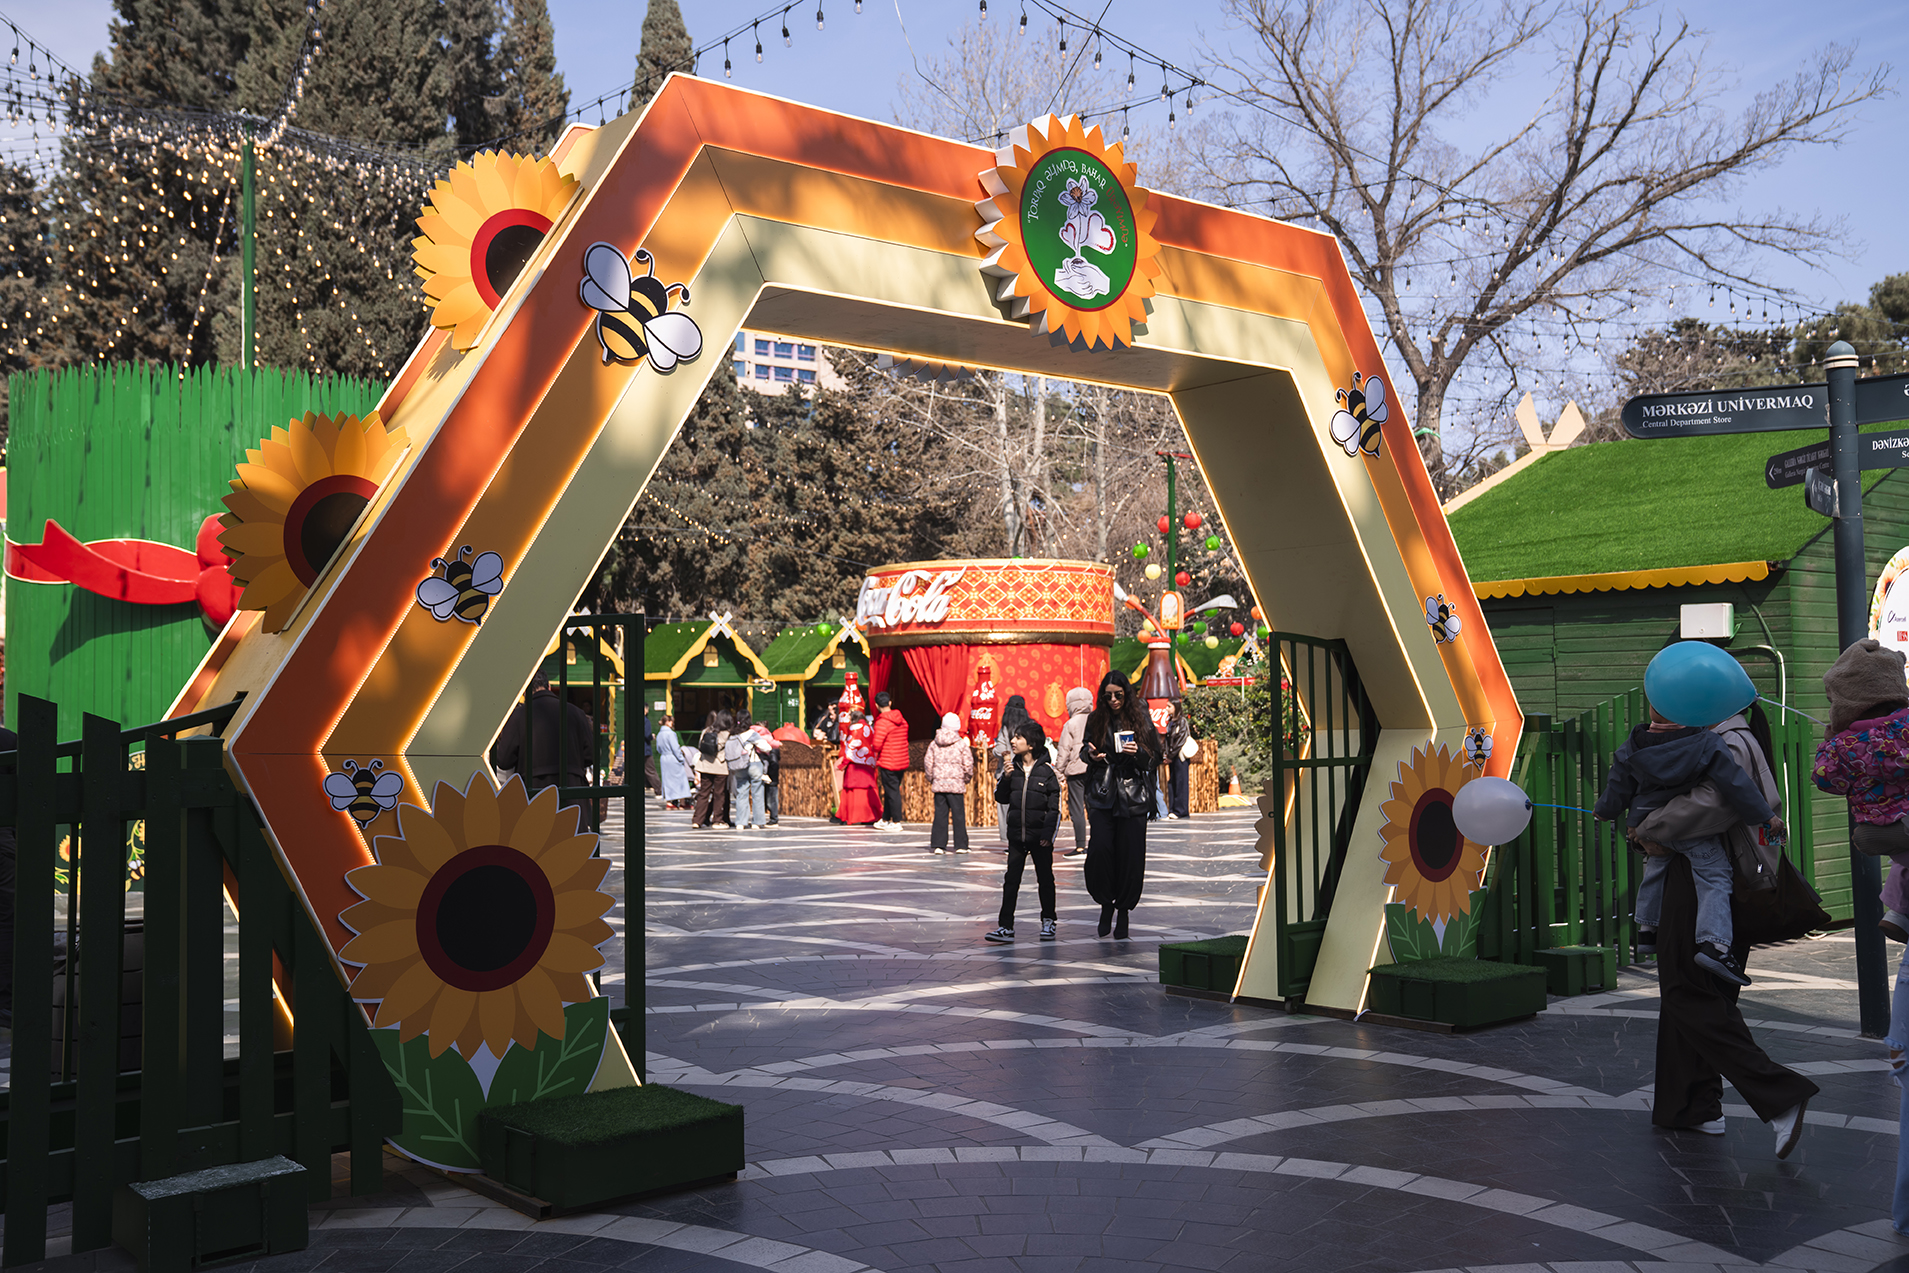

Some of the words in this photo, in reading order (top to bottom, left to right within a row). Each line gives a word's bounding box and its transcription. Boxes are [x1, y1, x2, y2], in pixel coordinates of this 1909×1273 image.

[1081, 163, 1107, 190] BAHAR
[1642, 399, 1713, 418] MƏRKƏZİ
[1717, 394, 1814, 413] UNİVERMAQ
[1642, 419, 1668, 429] Central
[1670, 417, 1711, 428] Department
[1713, 415, 1732, 424] Store
